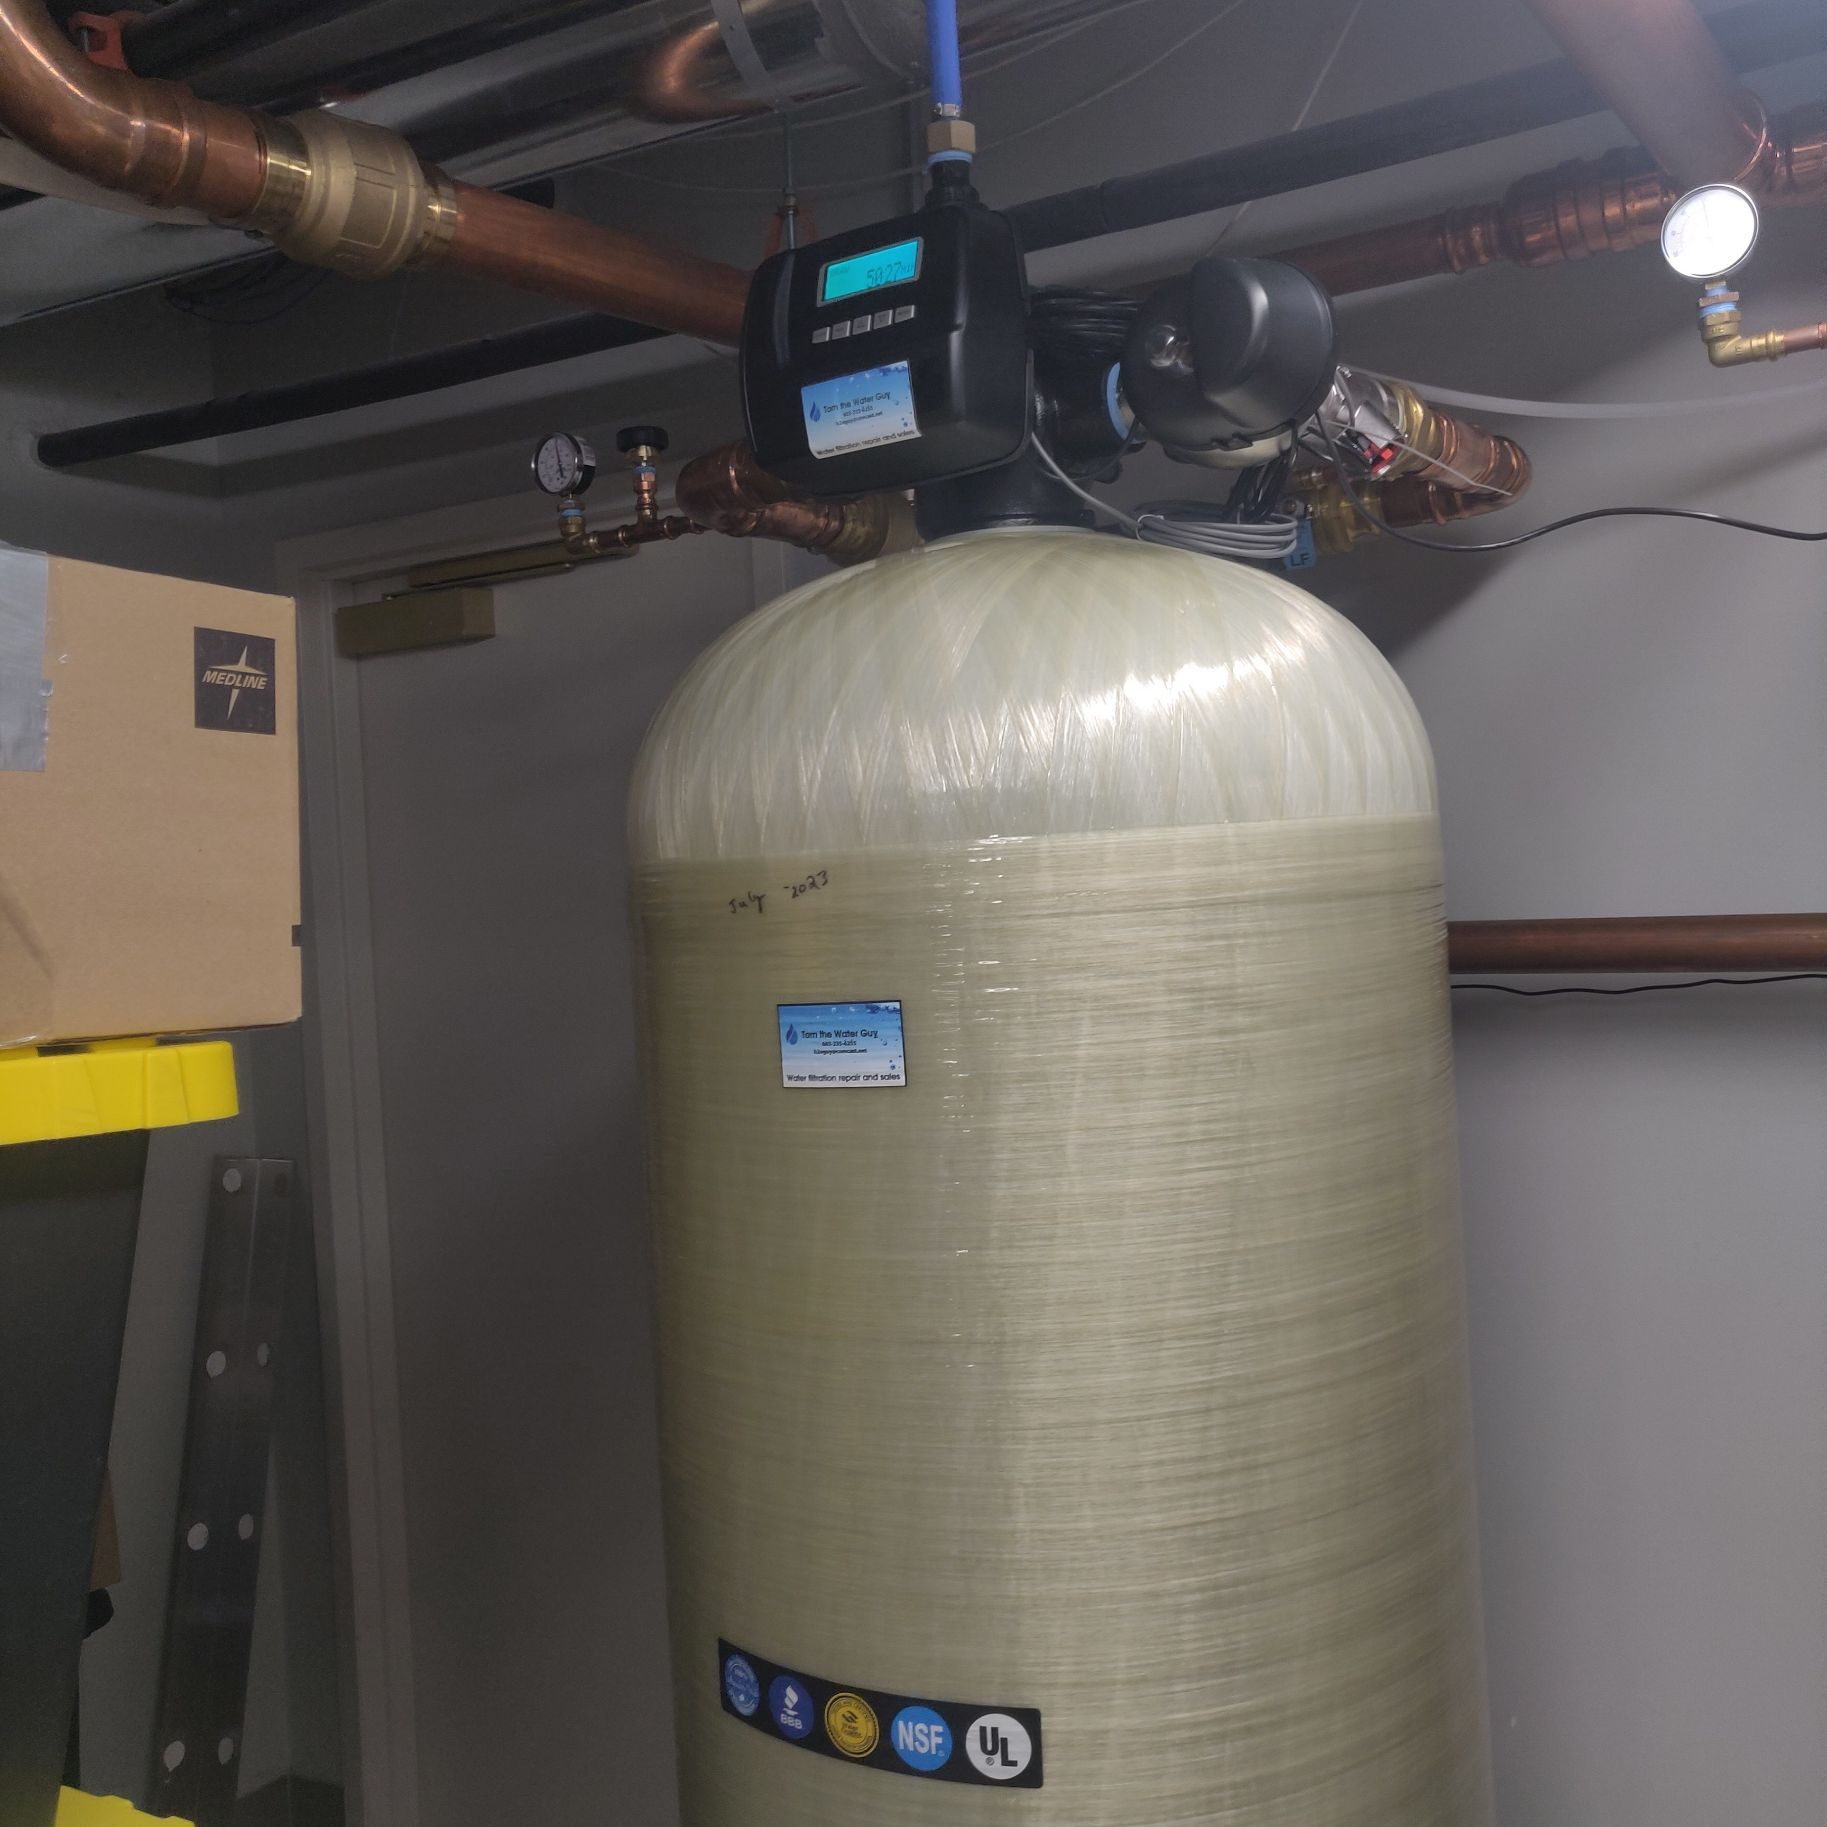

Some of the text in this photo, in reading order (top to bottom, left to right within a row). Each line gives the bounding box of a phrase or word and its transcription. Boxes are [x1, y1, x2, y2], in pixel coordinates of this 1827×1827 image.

[840, 401, 852, 410] the
[853, 396, 875, 407] Water
[875, 392, 891, 402] Guy
[816, 447, 835, 456] Water
[862, 437, 882, 446] repair
[897, 429, 915, 438] sales
[1290, 552, 1310, 567] LF
[202, 670, 268, 690] MEDLINE
[728, 890, 767, 914] July
[820, 1030, 833, 1039] the
[834, 1029, 859, 1039] Water
[860, 1028, 879, 1039] Guy
[786, 1072, 901, 1084] Water filtration repair and sales
[779, 1713, 803, 1730] BBB
[898, 1720, 944, 1755] NSF
[979, 1725, 1018, 1767] UL
